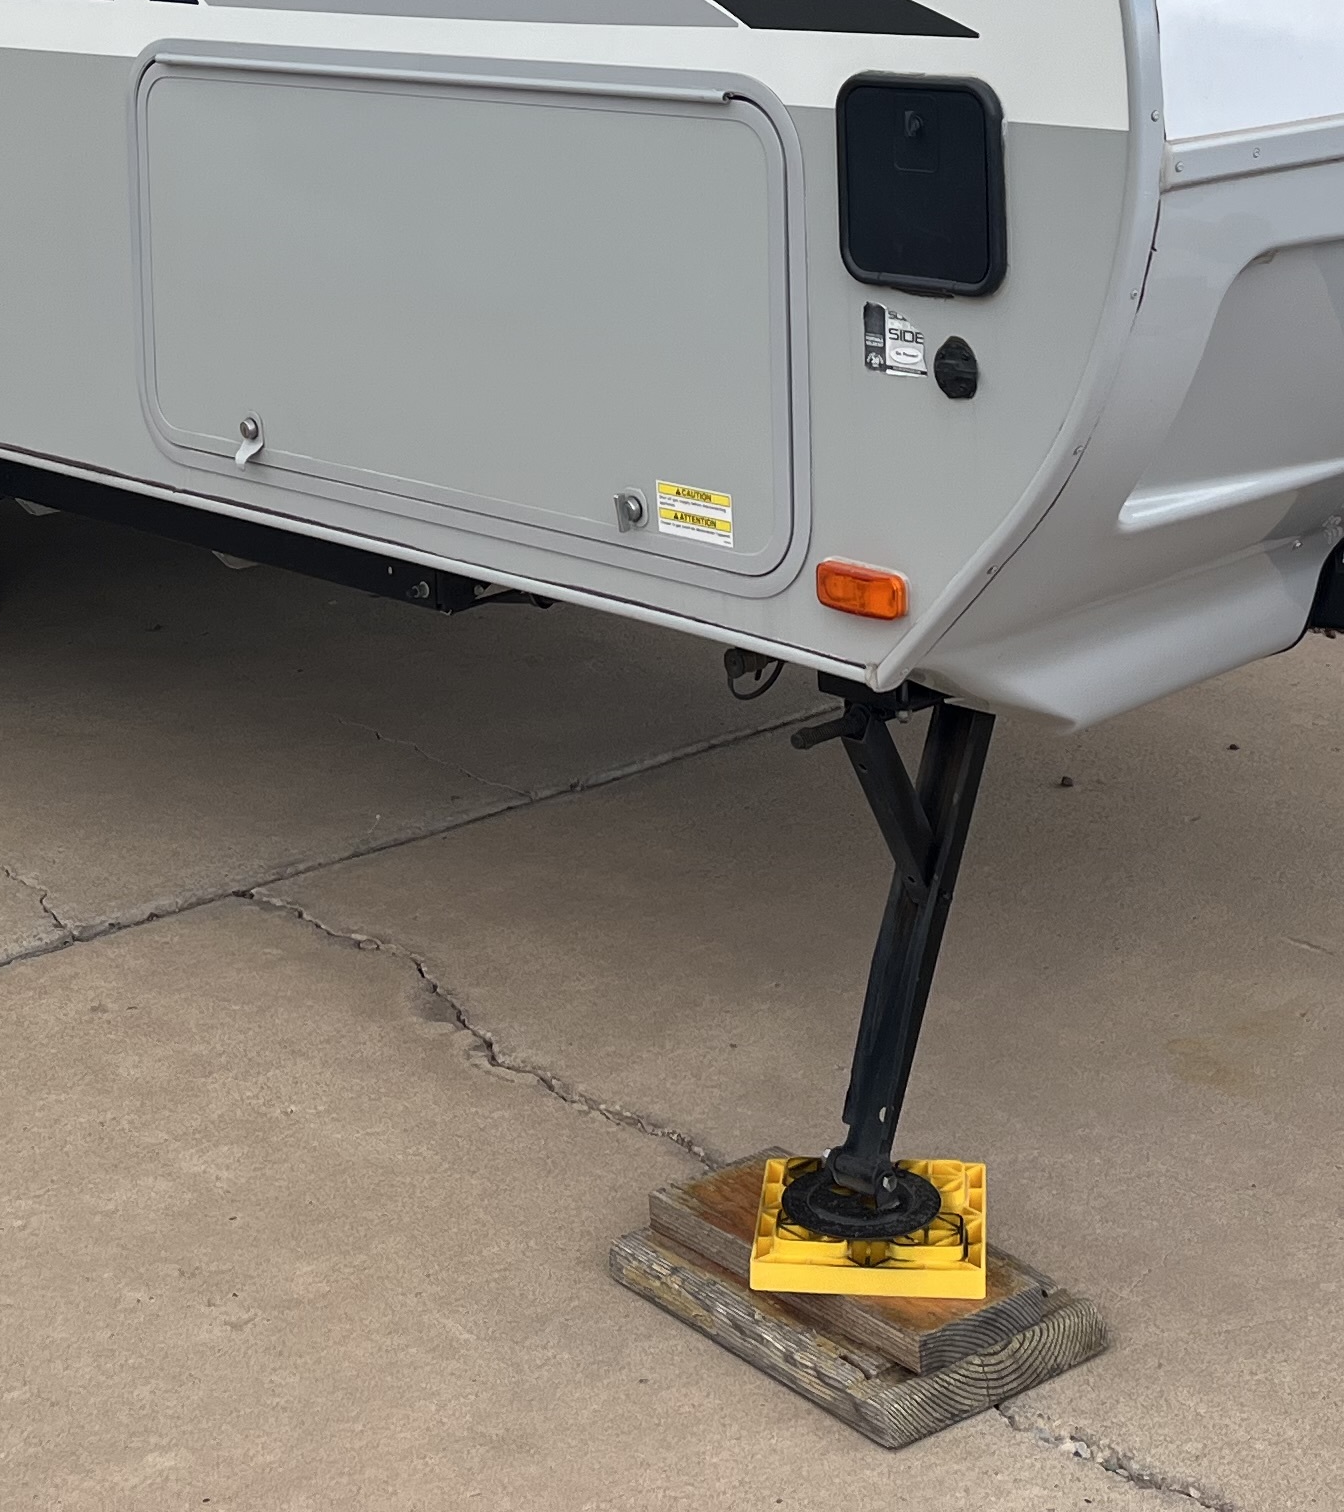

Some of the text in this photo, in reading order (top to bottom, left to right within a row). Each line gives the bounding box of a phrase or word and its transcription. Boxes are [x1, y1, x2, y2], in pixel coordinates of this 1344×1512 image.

[888, 328, 924, 344] SIDE
[681, 488, 712, 502] CAUTION
[680, 512, 717, 528] ATTENTION
